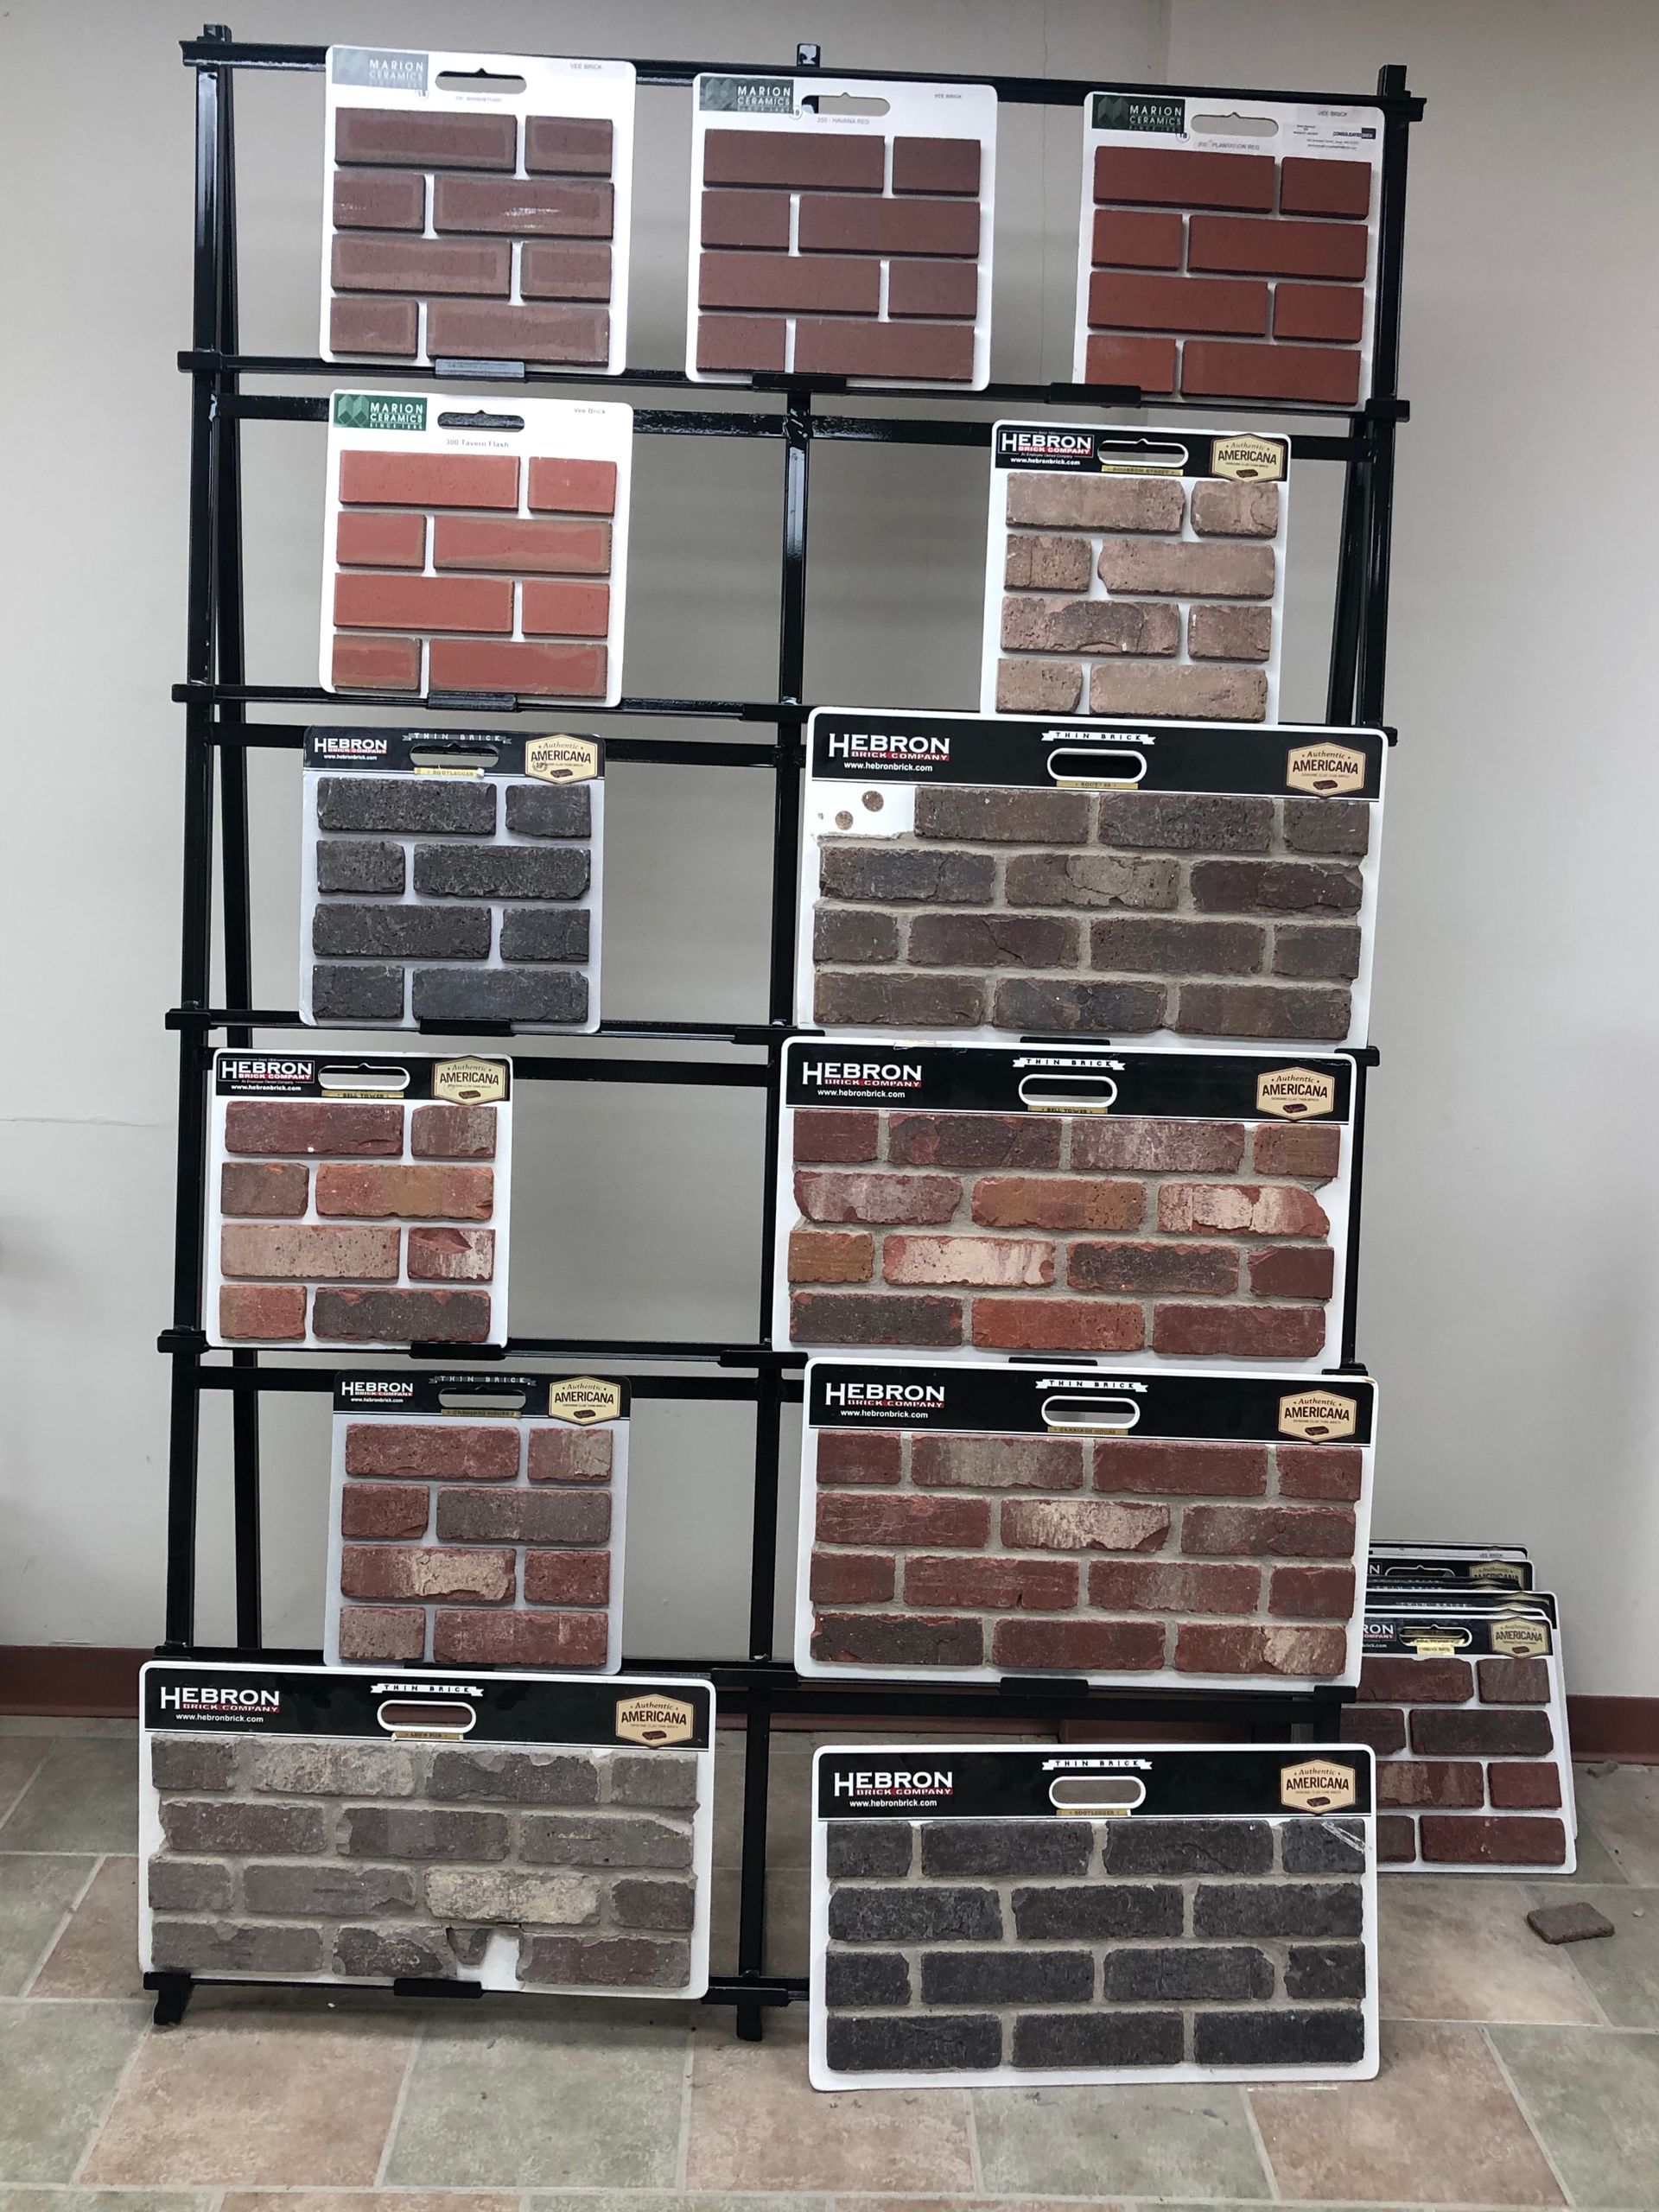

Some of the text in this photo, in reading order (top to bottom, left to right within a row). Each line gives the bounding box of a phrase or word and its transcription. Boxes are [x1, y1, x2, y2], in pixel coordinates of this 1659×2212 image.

[369, 59, 423, 72] MARION
[368, 71, 423, 81] CERAMICS
[737, 86, 791, 97] MARION
[737, 96, 791, 105] CERAMICS
[1129, 105, 1183, 117] MARION
[1128, 116, 1182, 125] CERAMICS
[370, 402, 423, 414] MARION
[370, 413, 423, 423] CERAMICS
[1001, 432, 1091, 452] HEBRON
[1230, 442, 1265, 450] Authentic
[1010, 457, 1081, 466] www.hebronbrick.com
[1217, 449, 1277, 465] AMERICANA
[314, 737, 387, 753] HEBRON
[543, 741, 579, 750] Authentic
[828, 733, 950, 758] HEBRON
[531, 749, 592, 764] AMERICANA
[891, 752, 949, 760] COMPANY
[1306, 751, 1345, 760] Authentic
[843, 761, 933, 772] www.hebronbrick.com
[1292, 760, 1358, 774] AMERICANA
[221, 1060, 312, 1079] HEBRON
[452, 1064, 487, 1072] Authentic
[802, 1061, 922, 1085] HEBRON
[440, 1071, 499, 1085] AMERICANA
[863, 1079, 921, 1088] COMPANY
[1275, 1074, 1314, 1084] Authentic
[817, 1089, 906, 1098] www.hebronbrick.com
[1262, 1084, 1327, 1098] AMERICANA
[341, 1382, 414, 1396] HEBRON
[567, 1382, 601, 1391] Authentic
[554, 1390, 614, 1404] AMERICANA
[825, 1382, 945, 1406] HEBRON
[1297, 1397, 1336, 1406] Authentic
[840, 1409, 929, 1419] www.hebronbrick.com
[1284, 1406, 1350, 1421] AMERICANA
[1495, 1630, 1543, 1643] AMERICANA
[160, 1687, 280, 1710] HEBRON
[222, 1704, 278, 1713] COMPANY
[635, 1701, 673, 1711] Authentic
[175, 1713, 264, 1723] www.hebronbrick.com
[621, 1710, 687, 1726] AMERICANA
[1299, 1767, 1336, 1776] Authentic
[834, 1771, 953, 1796] HEBRON
[1286, 1777, 1350, 1790] AMERICANA
[849, 1798, 938, 1808] www.hebronbrick.com
